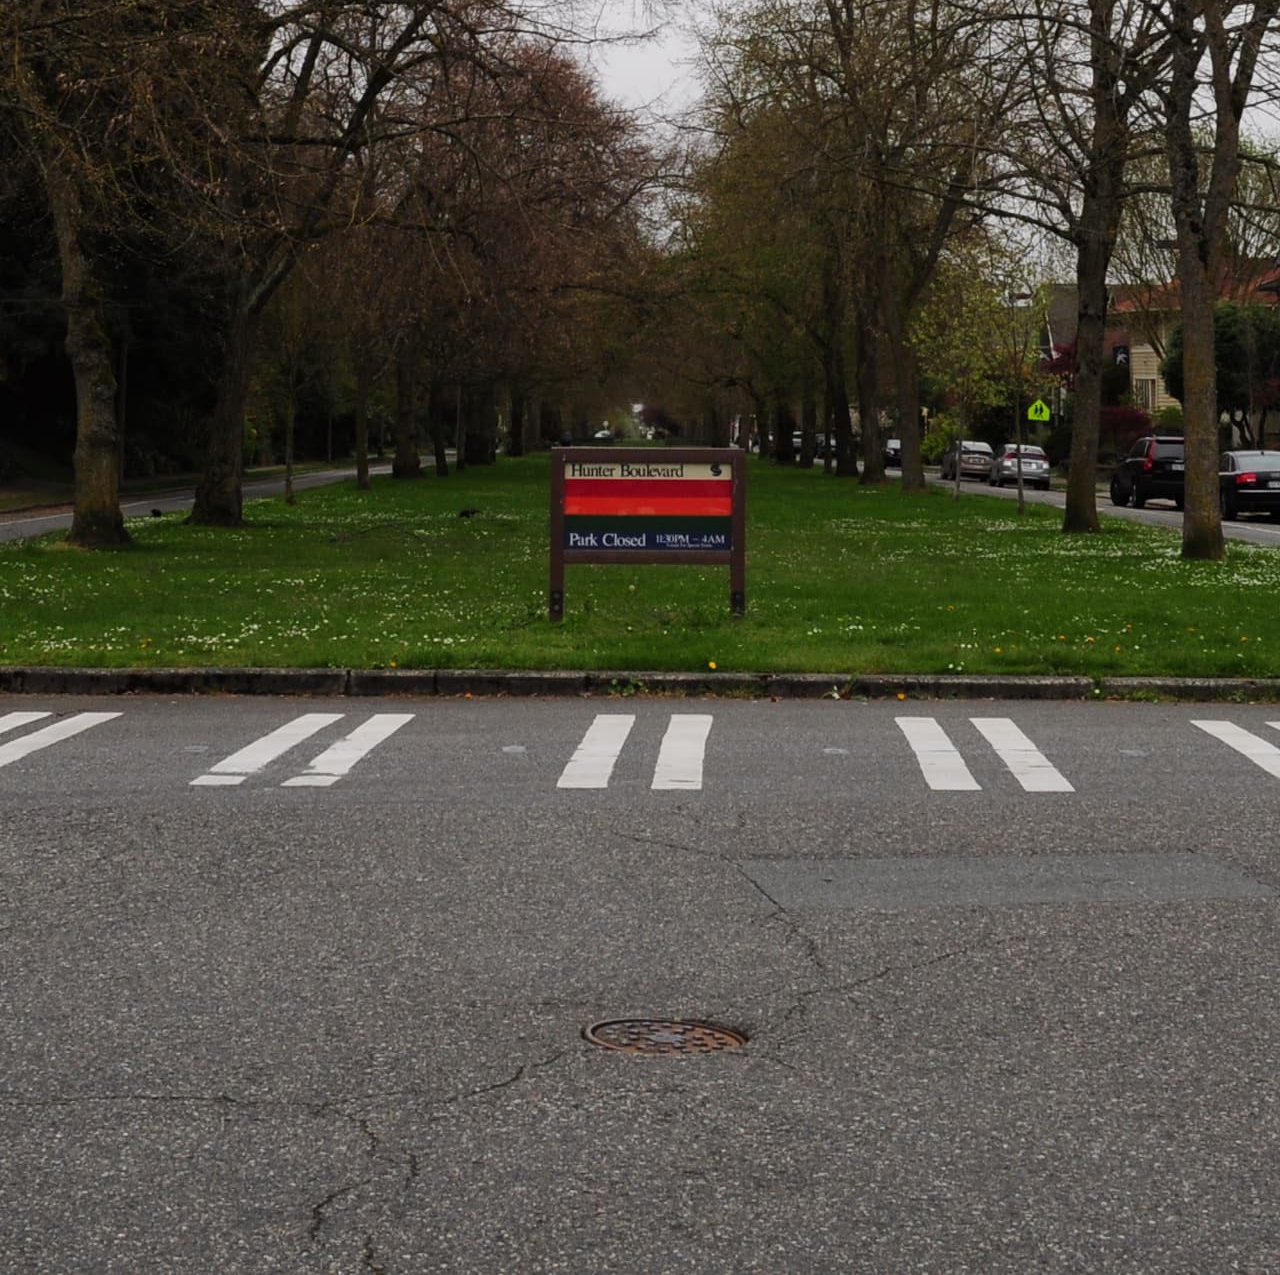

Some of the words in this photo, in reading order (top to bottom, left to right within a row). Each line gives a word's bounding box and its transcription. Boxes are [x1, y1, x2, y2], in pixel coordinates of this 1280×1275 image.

[571, 463, 616, 478] Hunter
[620, 463, 684, 478] Boulevard
[569, 533, 597, 547] Park
[602, 532, 646, 547] Closed
[702, 534, 725, 544] 4AM
